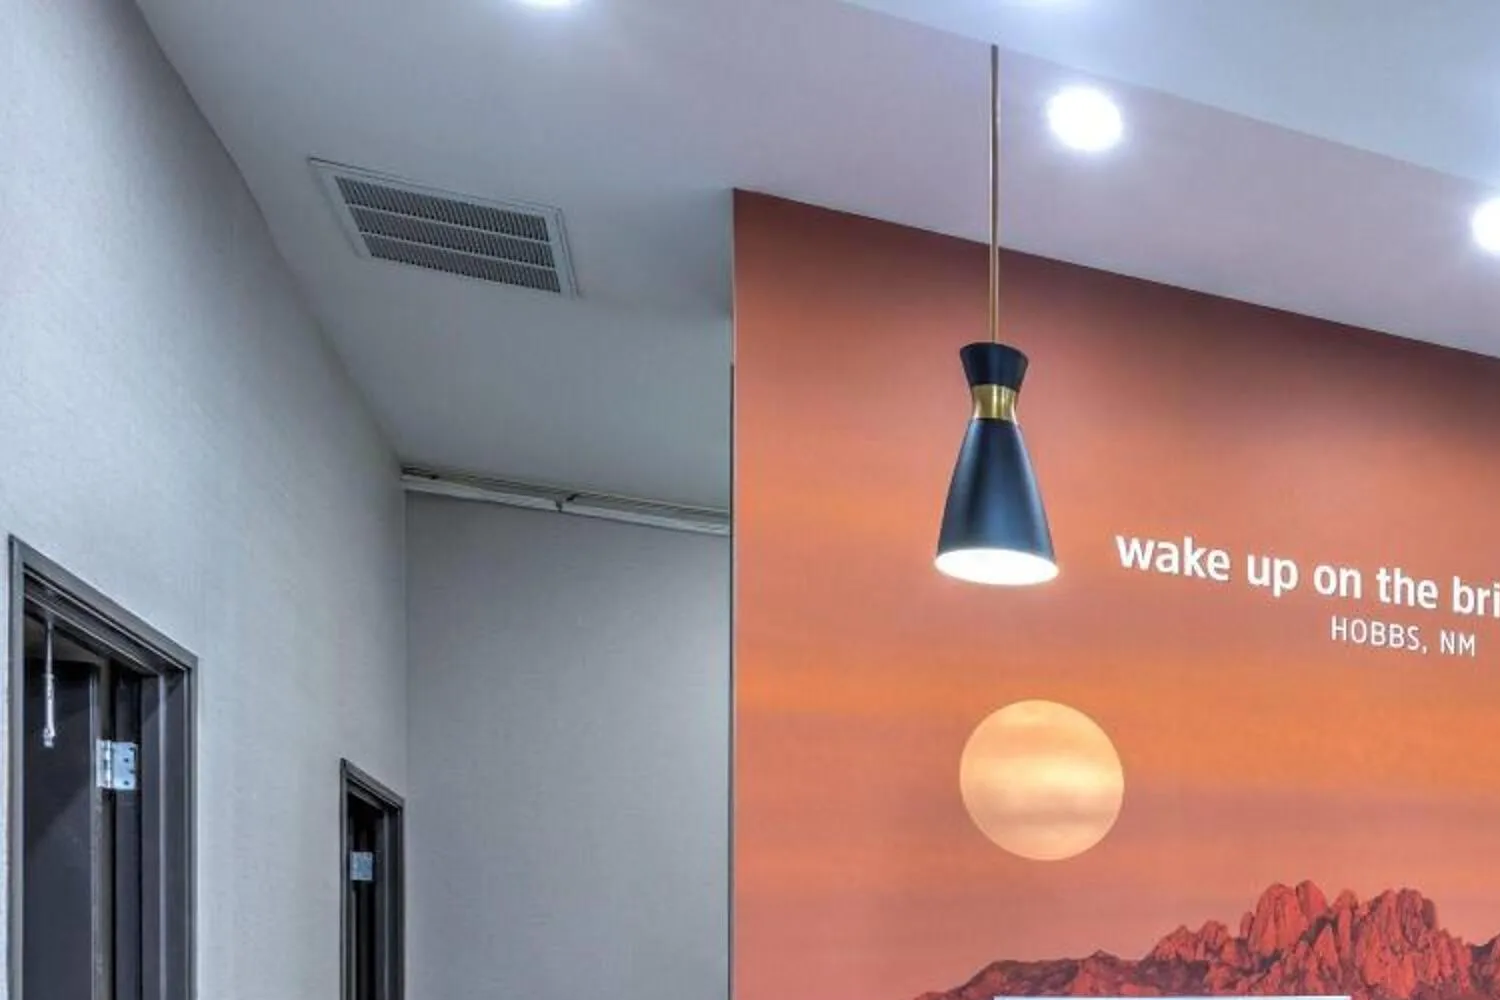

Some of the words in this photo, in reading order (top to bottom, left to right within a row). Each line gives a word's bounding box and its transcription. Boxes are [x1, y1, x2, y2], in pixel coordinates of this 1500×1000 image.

[1115, 535, 1231, 581] wake
[1247, 554, 1299, 598] up
[1313, 564, 1362, 599] on
[1375, 567, 1439, 609] the
[1331, 615, 1427, 654] HOBBS,
[1439, 629, 1475, 657] NM
